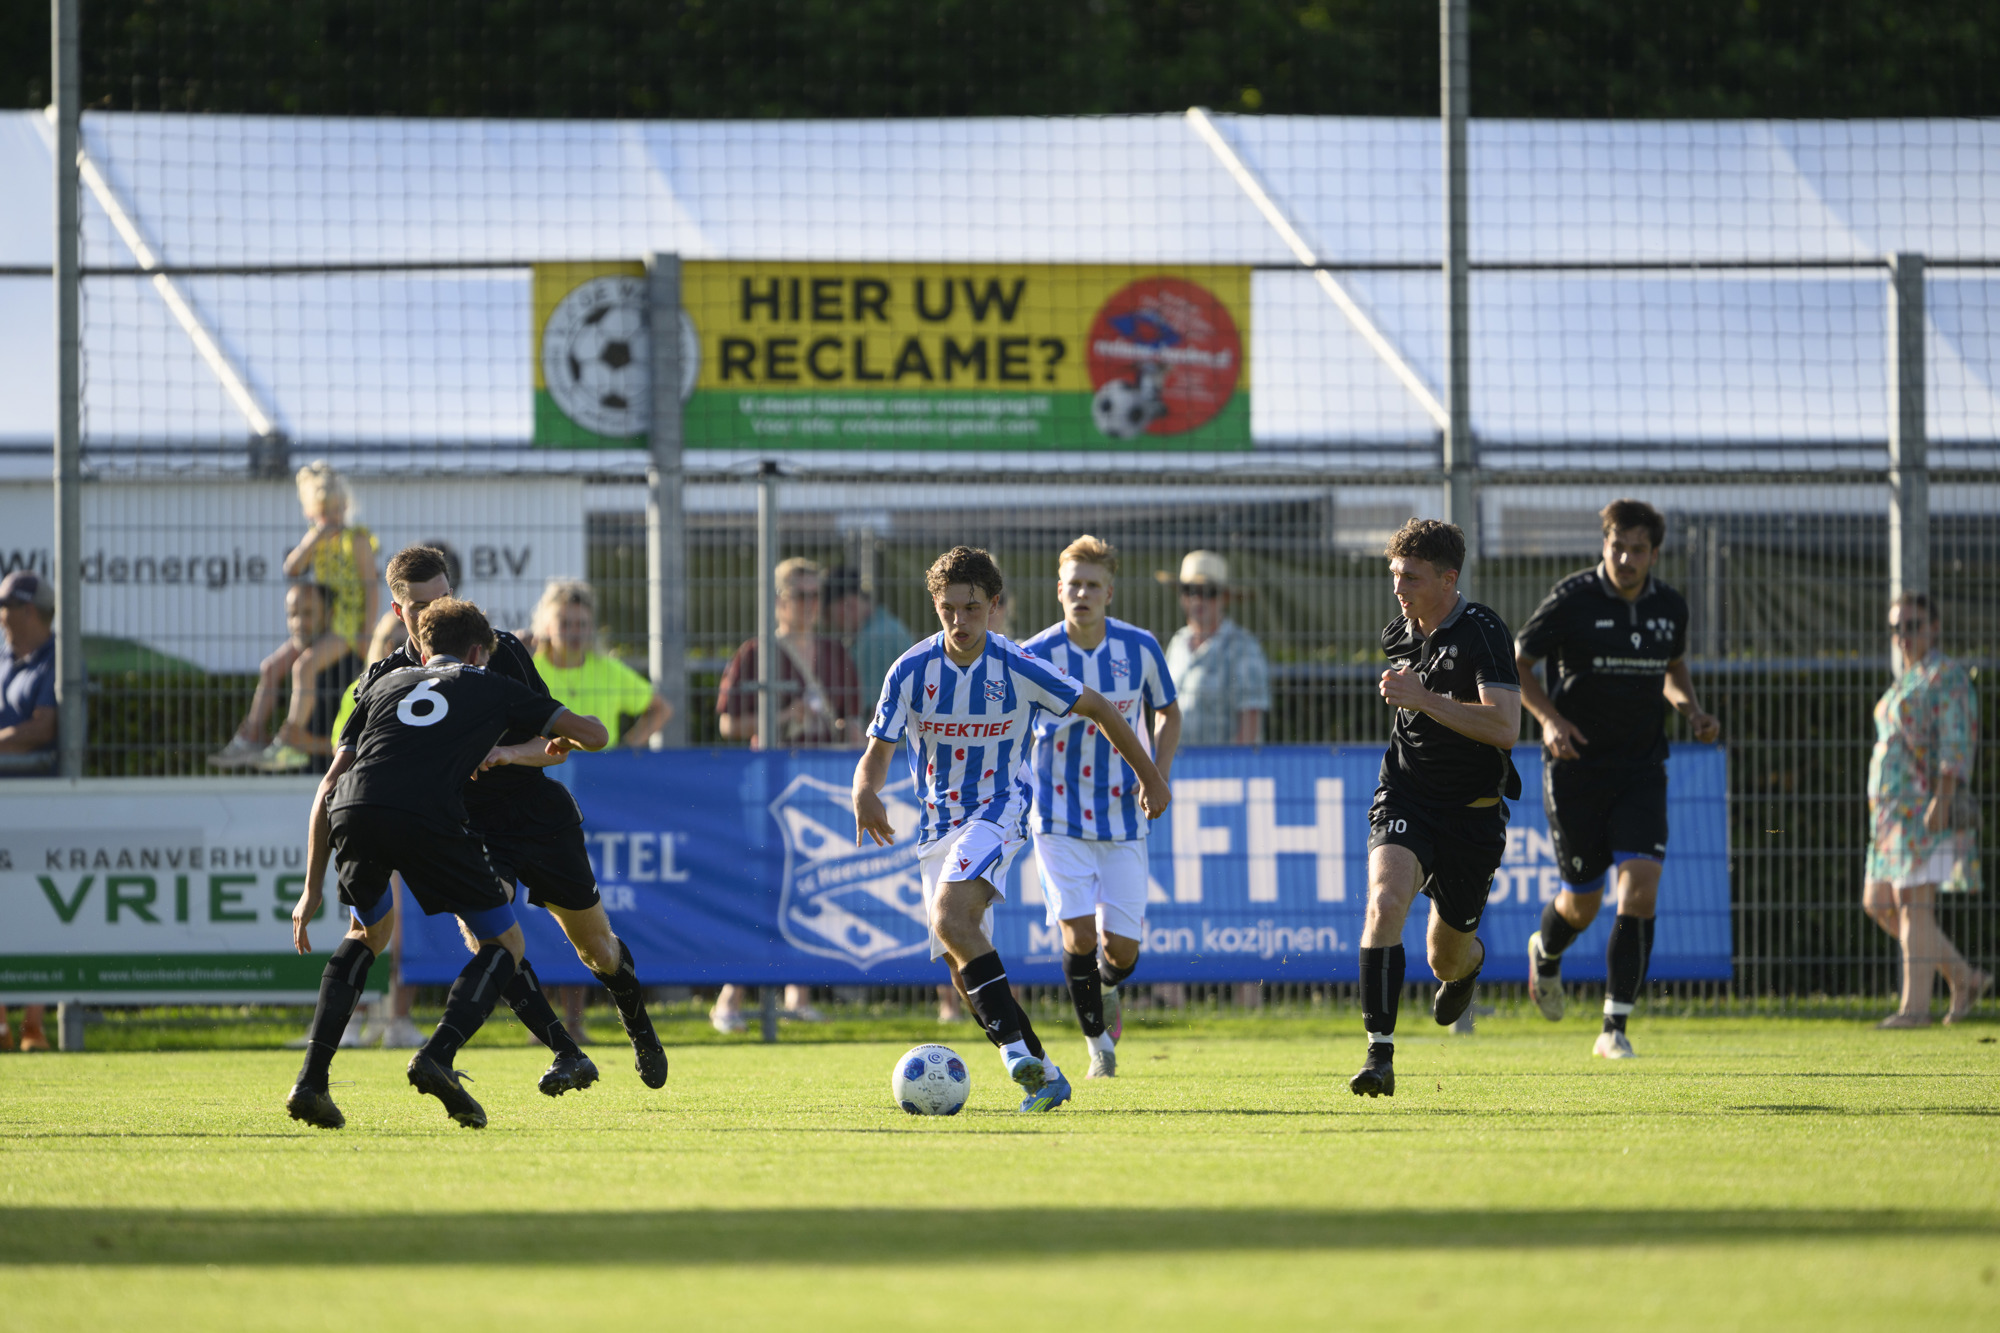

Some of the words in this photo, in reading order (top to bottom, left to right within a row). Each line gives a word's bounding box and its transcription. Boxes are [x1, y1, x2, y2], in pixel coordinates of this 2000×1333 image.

[739, 276, 892, 323] HIER
[913, 276, 1027, 323] UW
[718, 336, 1066, 383] RECLAME?
[0, 548, 268, 592] Widenergie
[473, 546, 530, 577] BV
[1630, 632, 1642, 650] 9
[396, 677, 449, 727] 6
[919, 719, 1014, 738] EFFEKTIEF
[1387, 818, 1408, 834] 10
[45, 847, 301, 871] KRAANVERHUU
[585, 832, 690, 883] TEL
[1571, 856, 1583, 872] 9
[36, 874, 325, 924] VRIES
[1203, 920, 1348, 960] kozijnen.
